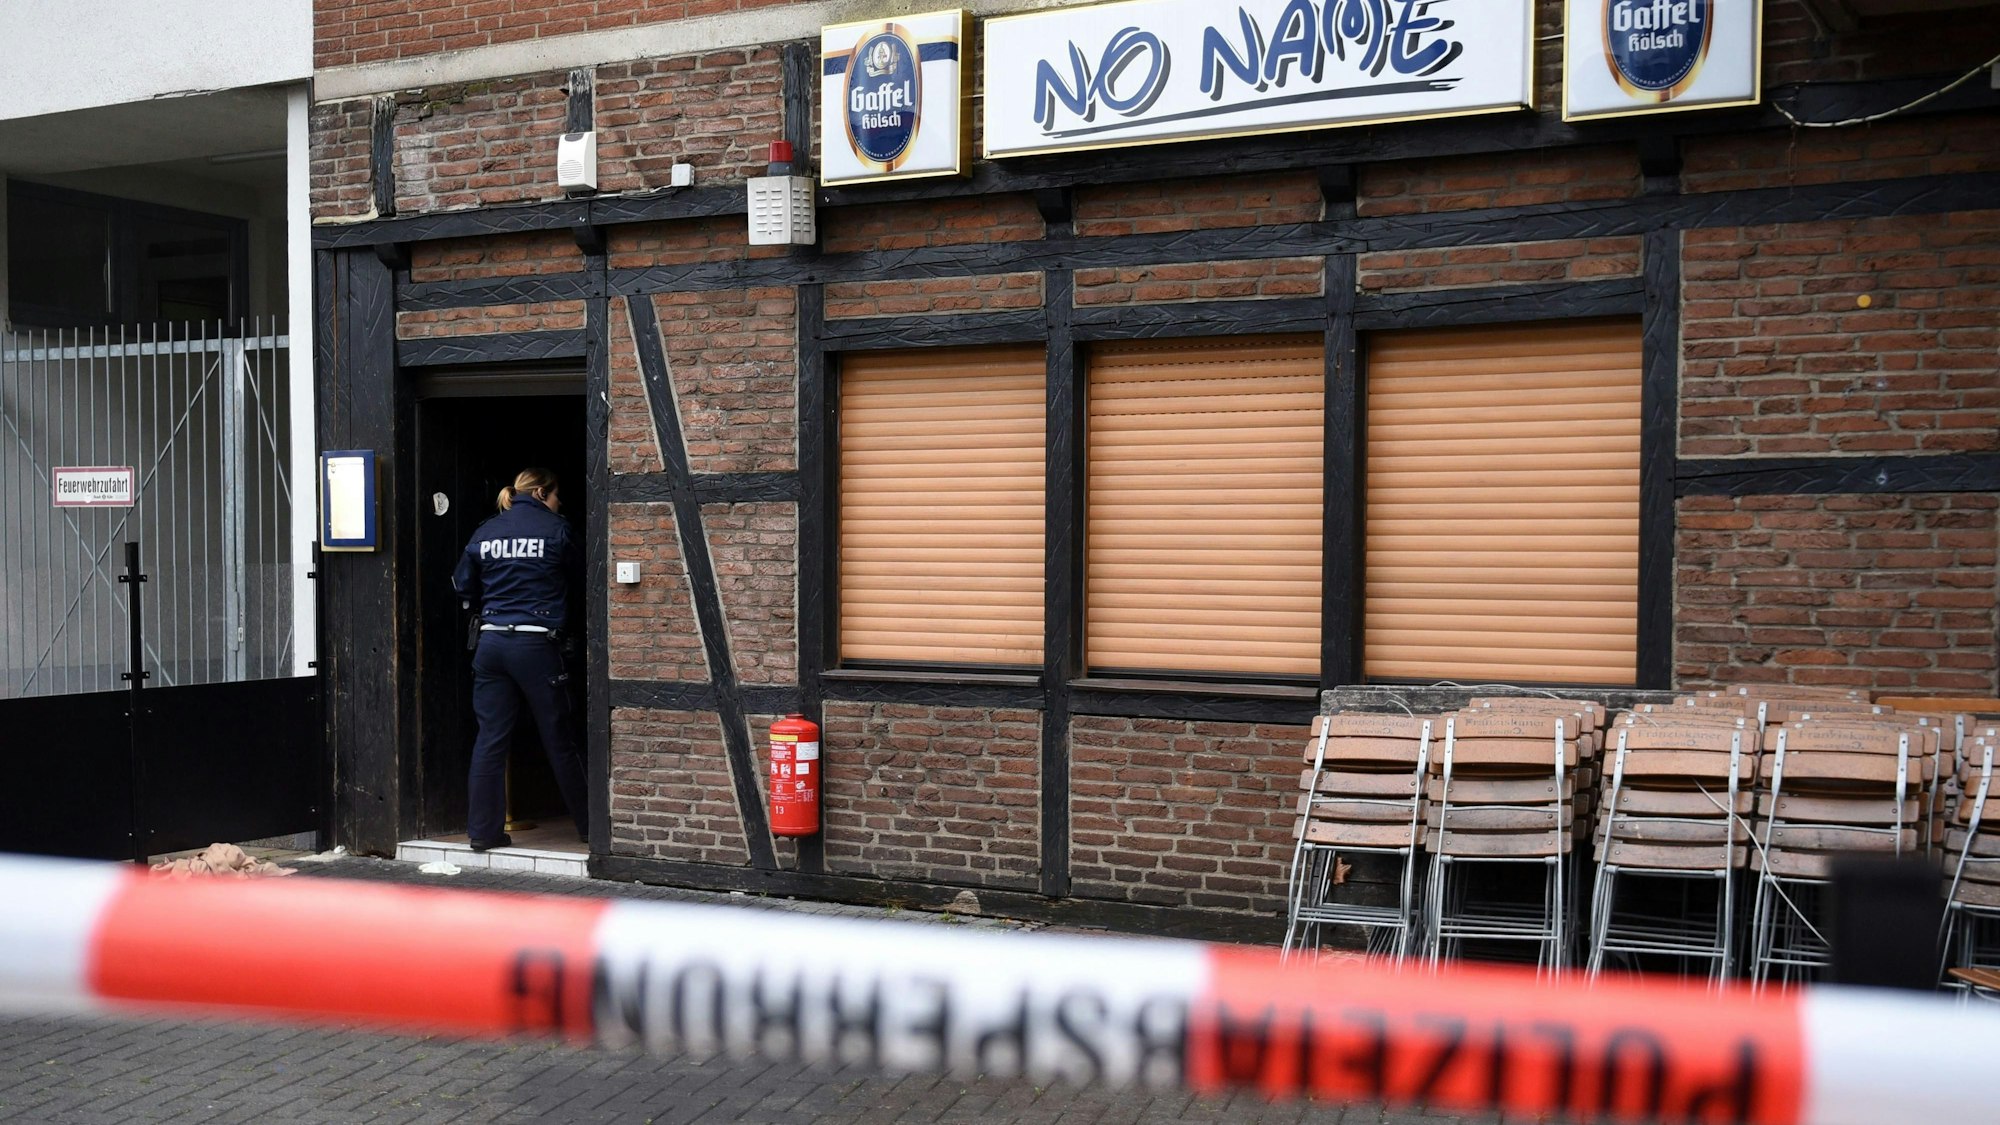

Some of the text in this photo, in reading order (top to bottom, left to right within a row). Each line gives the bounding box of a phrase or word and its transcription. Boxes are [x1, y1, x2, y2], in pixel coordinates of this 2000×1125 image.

[1628, 29, 1684, 52] Kölsch
[1033, 0, 1464, 128] NO NAME
[851, 80, 913, 113] Gaffel
[862, 112, 901, 130] Kölsch
[58, 477, 129, 493] Feuerwehrzufahrt
[480, 538, 545, 560] POLIZEI
[775, 805, 785, 815] 13
